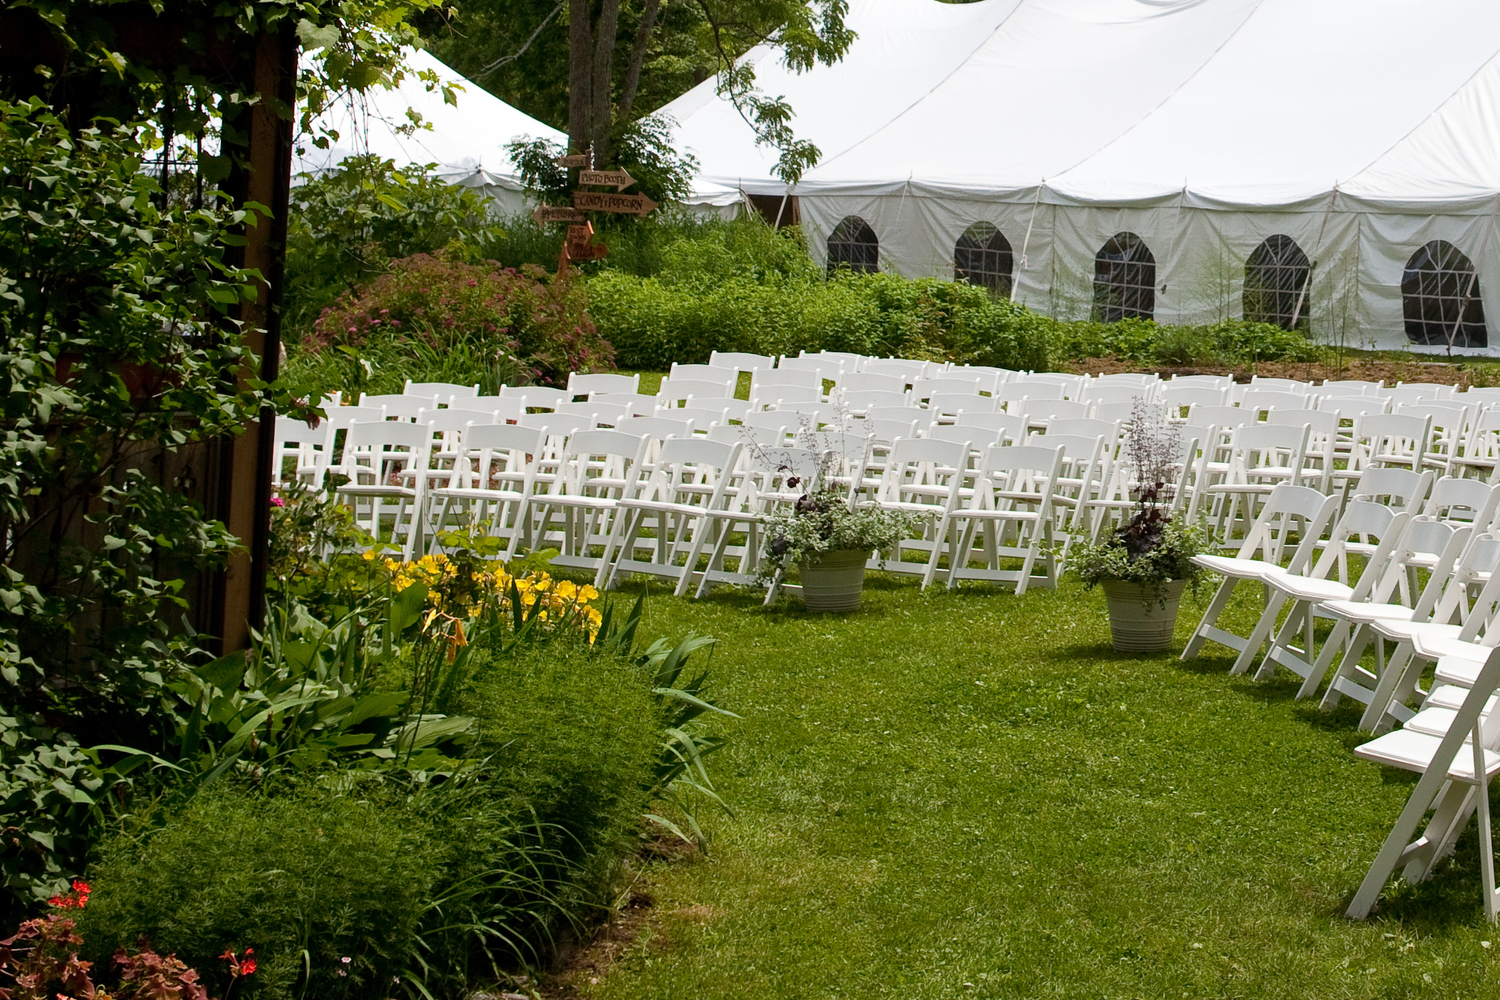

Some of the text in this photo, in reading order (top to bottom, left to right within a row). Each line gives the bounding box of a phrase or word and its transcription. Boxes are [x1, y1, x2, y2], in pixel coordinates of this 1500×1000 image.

[581, 173, 626, 185] PHOTO BOOTH
[580, 195, 605, 208] CANDY
[608, 196, 643, 210] POPCORN
